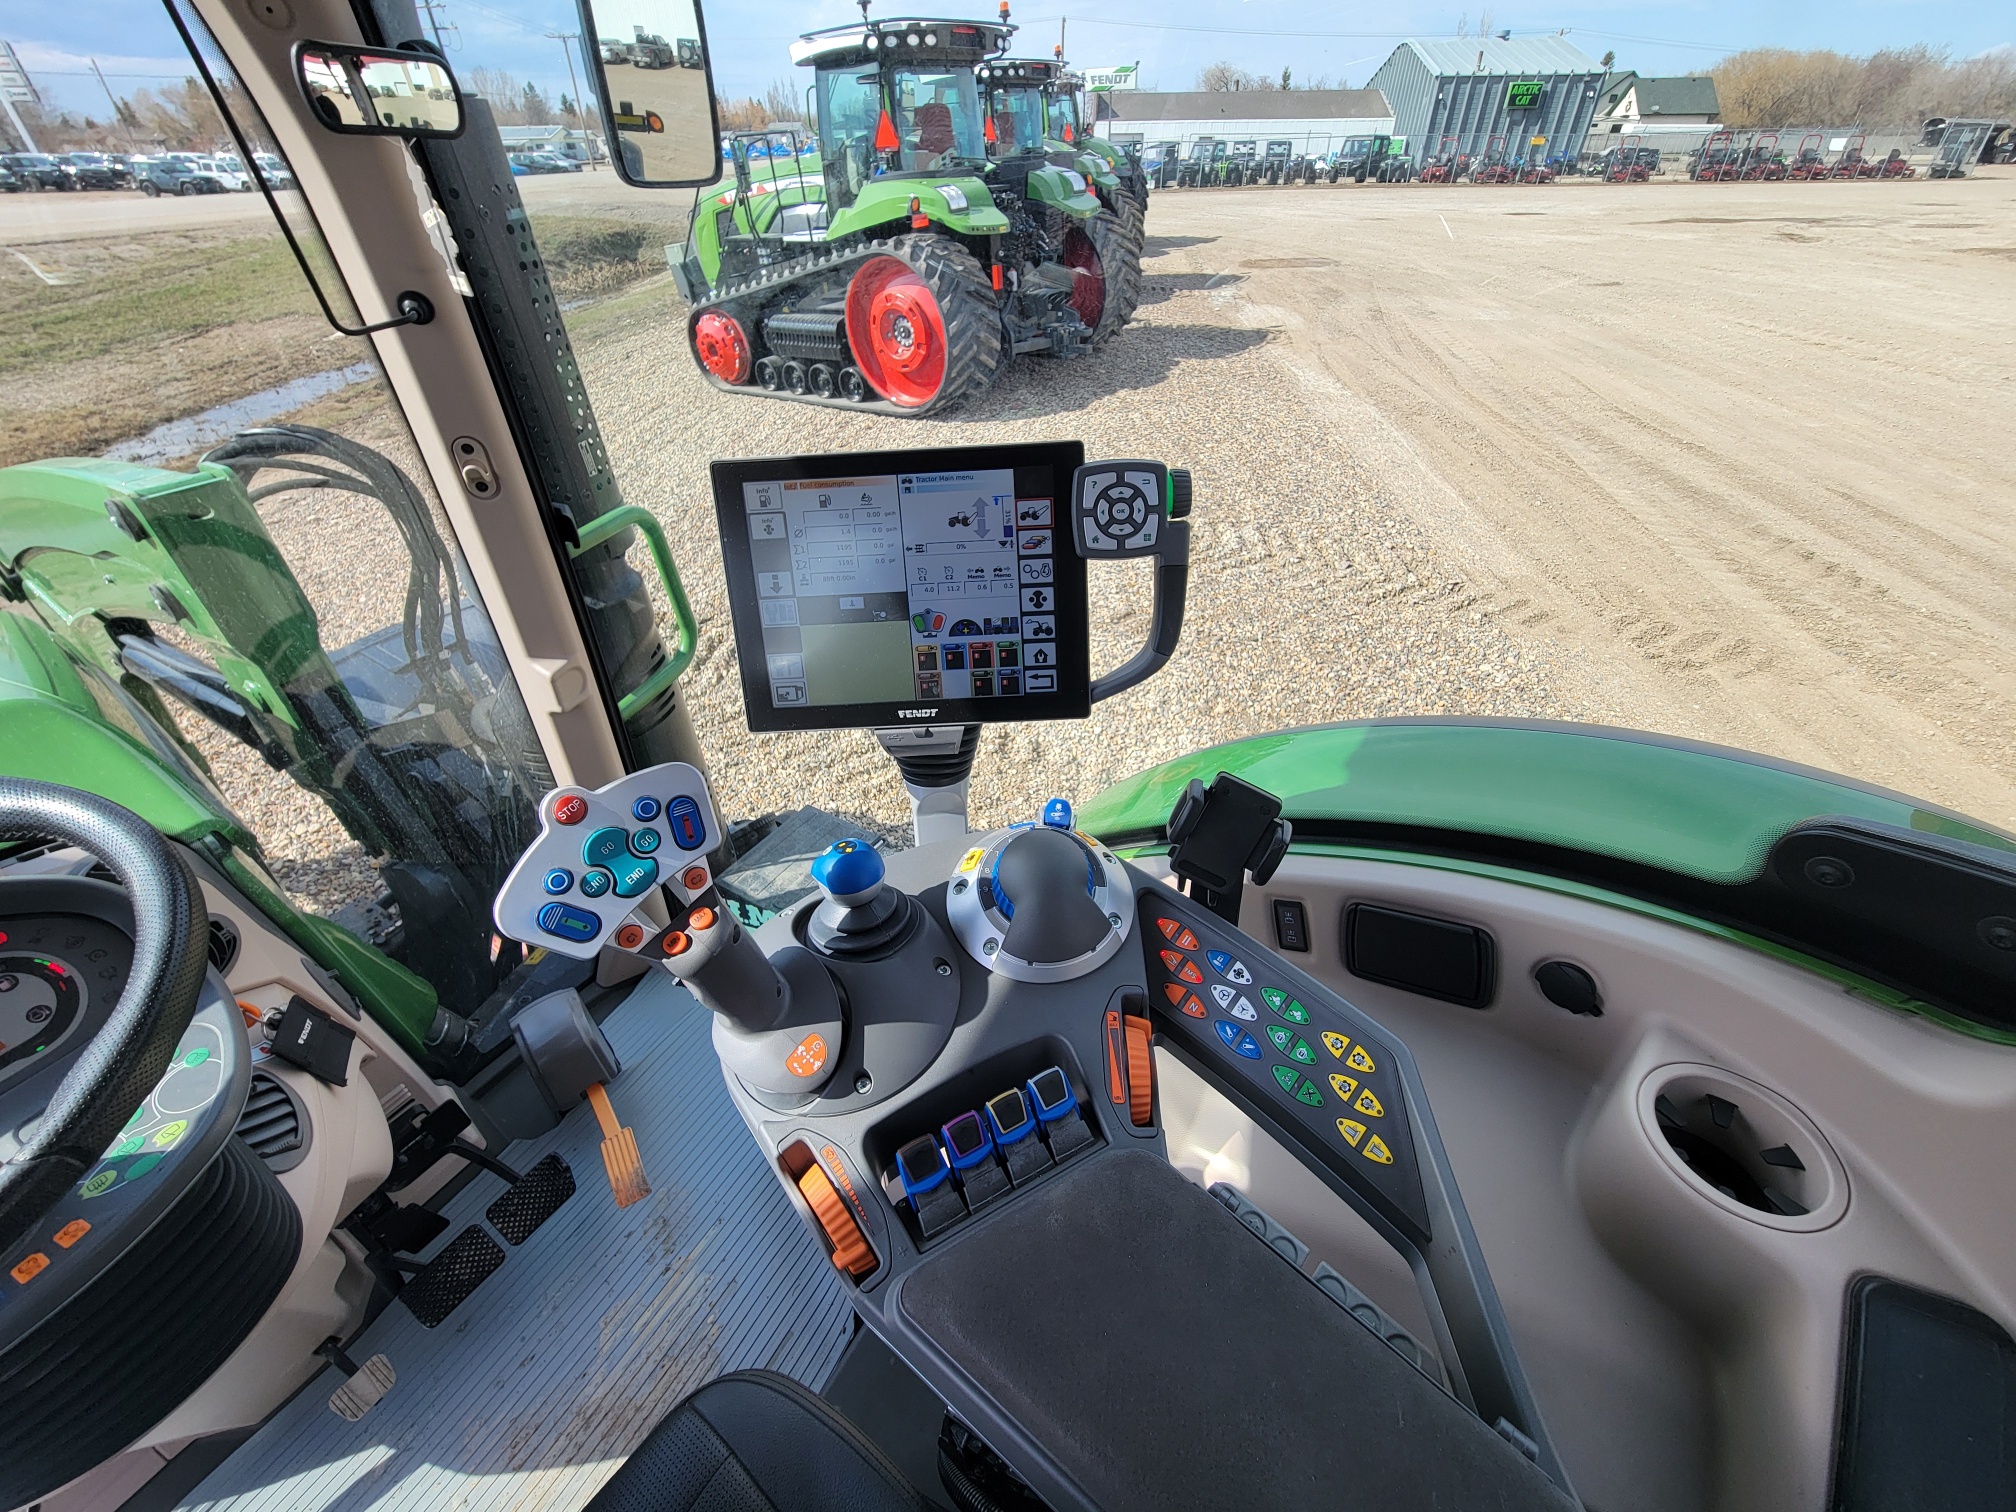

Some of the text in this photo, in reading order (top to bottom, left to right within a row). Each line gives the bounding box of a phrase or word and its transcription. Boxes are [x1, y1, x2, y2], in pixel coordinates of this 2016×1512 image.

[1090, 74, 1131, 85] FENDT
[1512, 84, 1542, 95] ARCTIC
[1515, 95, 1532, 105] CAT
[814, 480, 855, 488] consumption
[915, 476, 937, 484] Tractor
[897, 708, 939, 719] FENDT
[557, 799, 581, 821] STOP
[640, 834, 654, 847] GO
[600, 841, 615, 855] GO
[625, 867, 645, 886] END
[690, 873, 704, 886] C2
[586, 877, 605, 894] END
[694, 910, 708, 924] MAX
[626, 932, 638, 944] C1
[666, 935, 681, 949] MIN
[1184, 966, 1197, 979] TMS
[1188, 1001, 1199, 1013] N
[297, 1017, 313, 1045] FENDT
